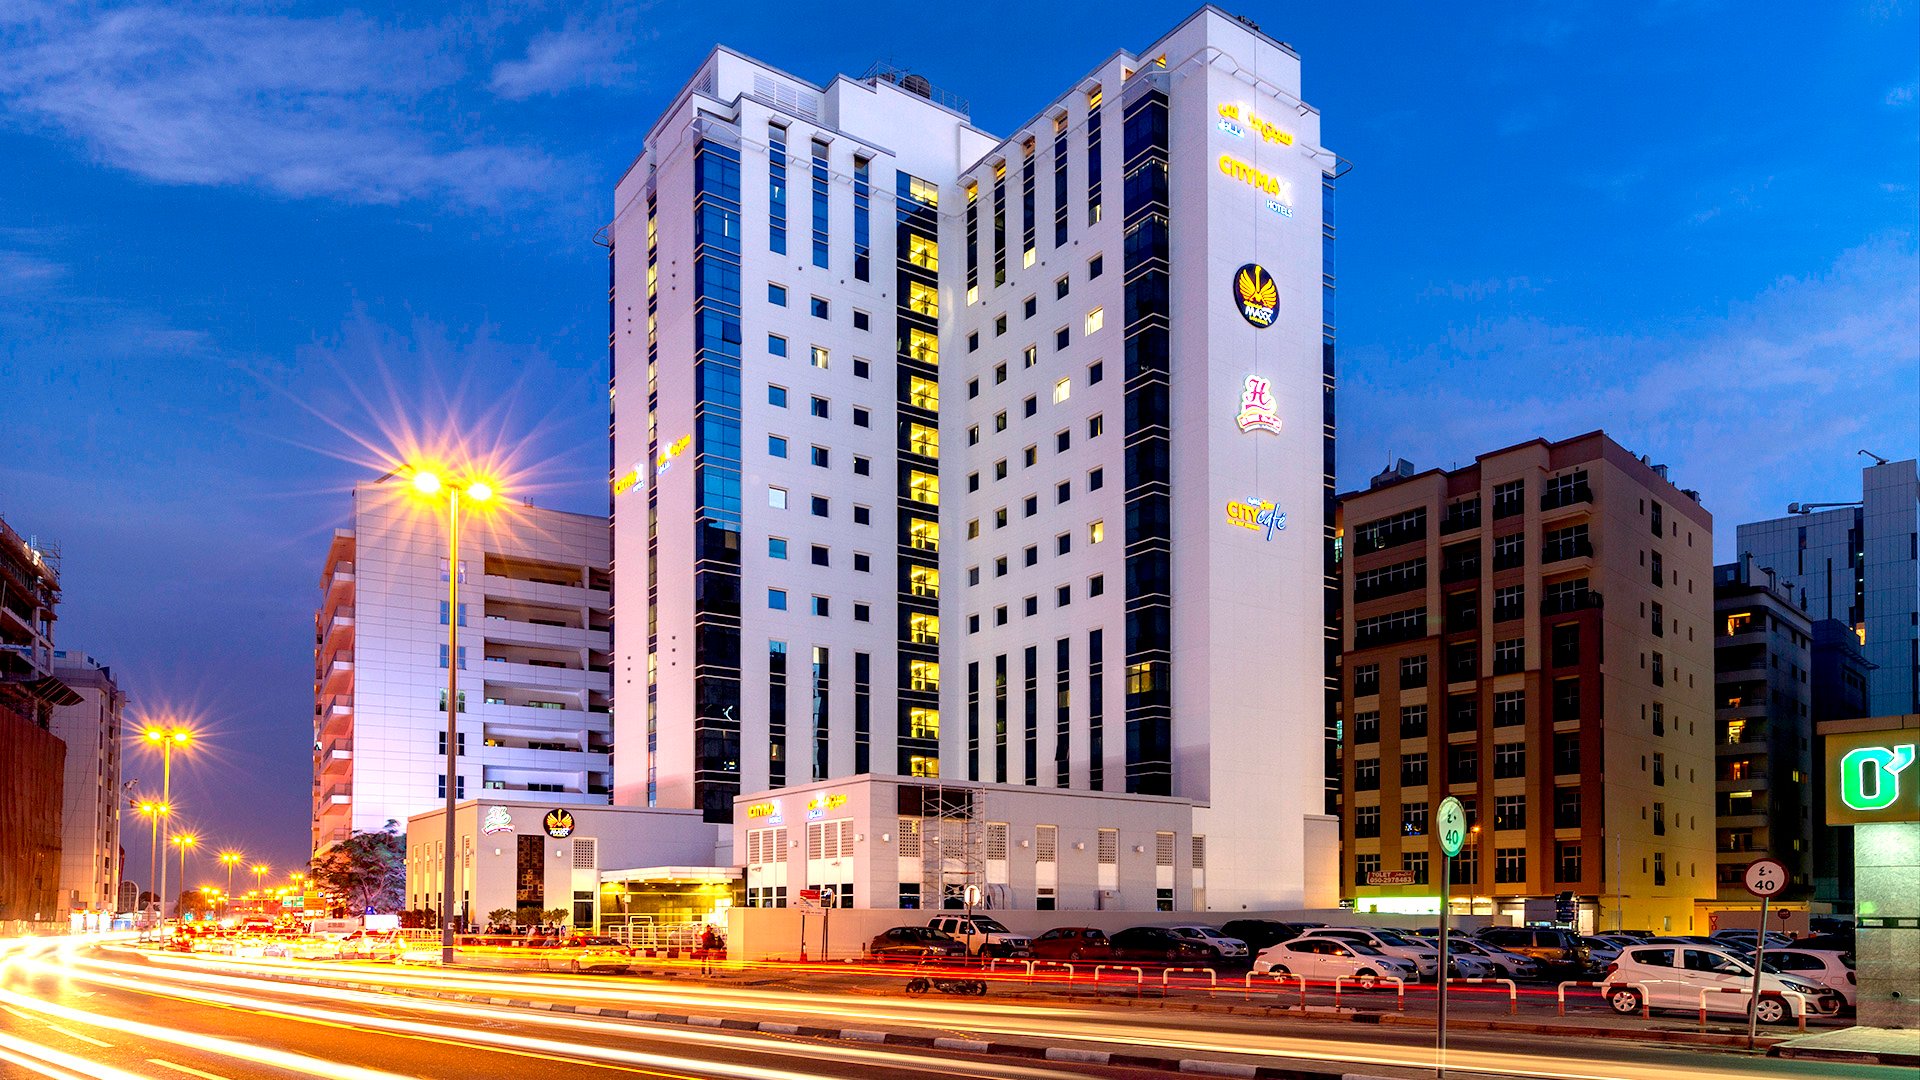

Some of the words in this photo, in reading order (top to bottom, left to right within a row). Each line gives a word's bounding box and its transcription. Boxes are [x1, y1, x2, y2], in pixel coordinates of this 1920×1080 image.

[1266, 199, 1293, 218] HOTELS
[1227, 501, 1260, 524] CITY
[1446, 829, 1459, 845] 40
[1758, 866, 1772, 876] ٤٠
[1754, 880, 1775, 891] 40
